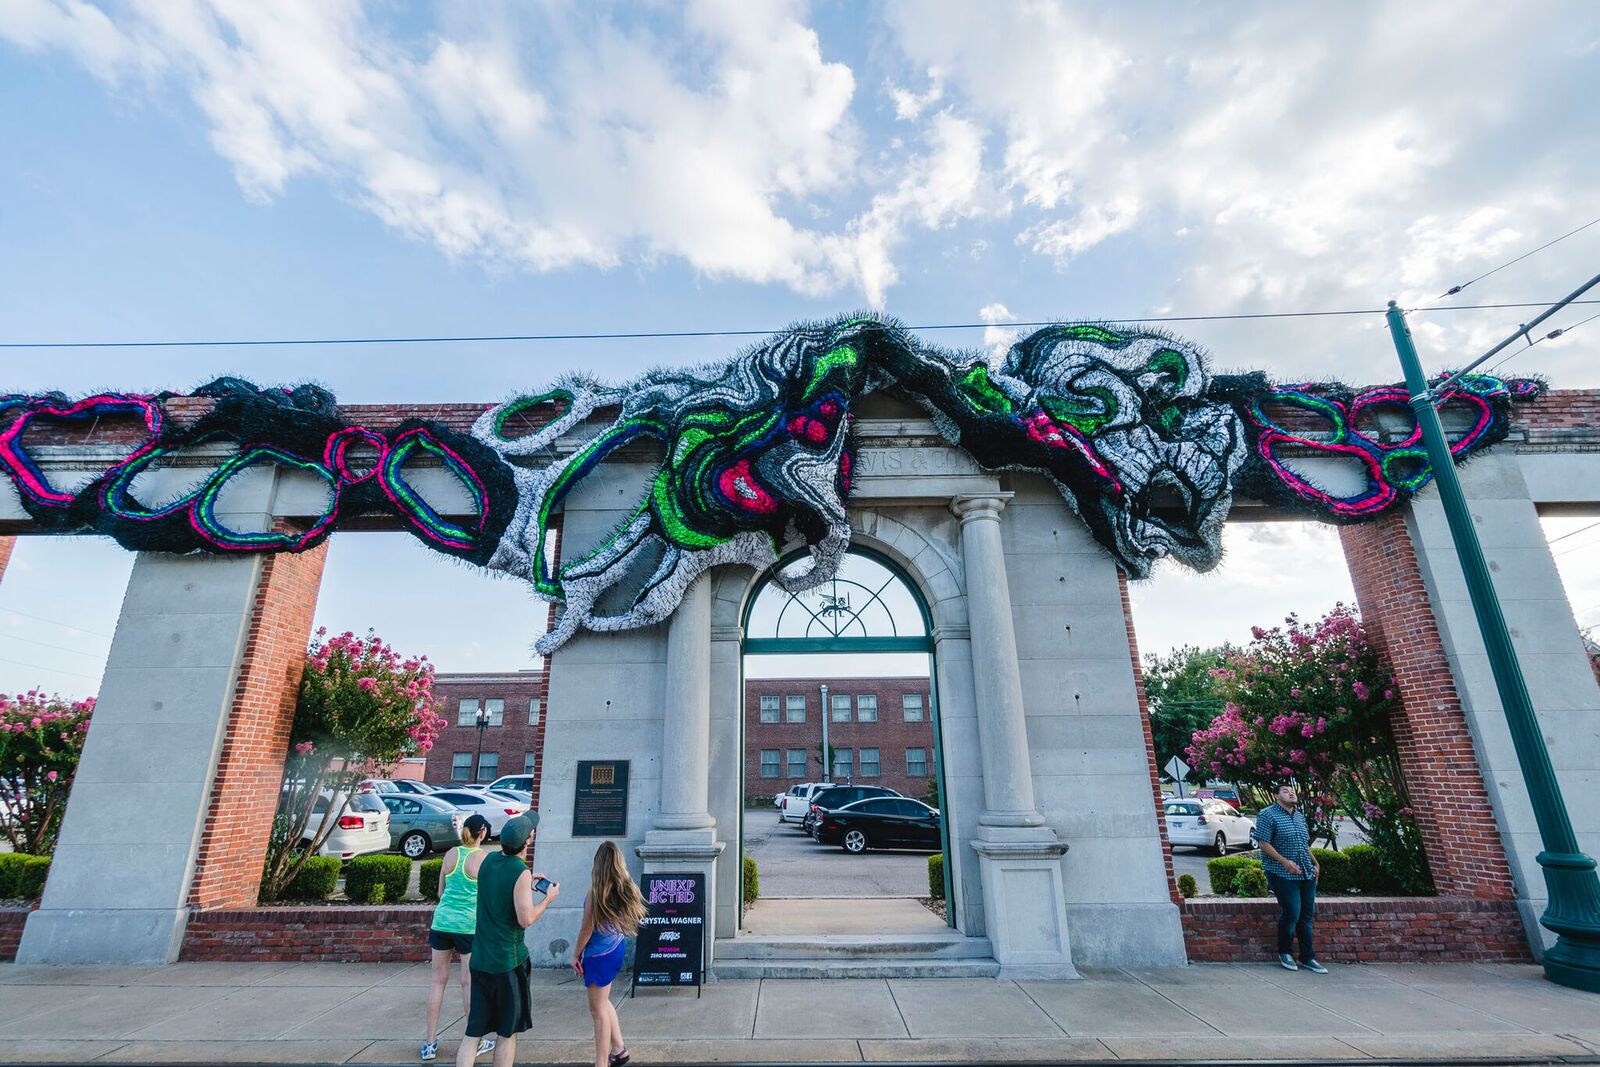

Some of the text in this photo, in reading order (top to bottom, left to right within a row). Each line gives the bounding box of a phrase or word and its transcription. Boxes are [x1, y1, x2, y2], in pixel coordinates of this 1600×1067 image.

[859, 451, 902, 471] VIS
[911, 451, 928, 470] &
[650, 880, 695, 891] UNEXP
[649, 891, 694, 903] ECTED
[640, 917, 670, 925] CRYSTAL
